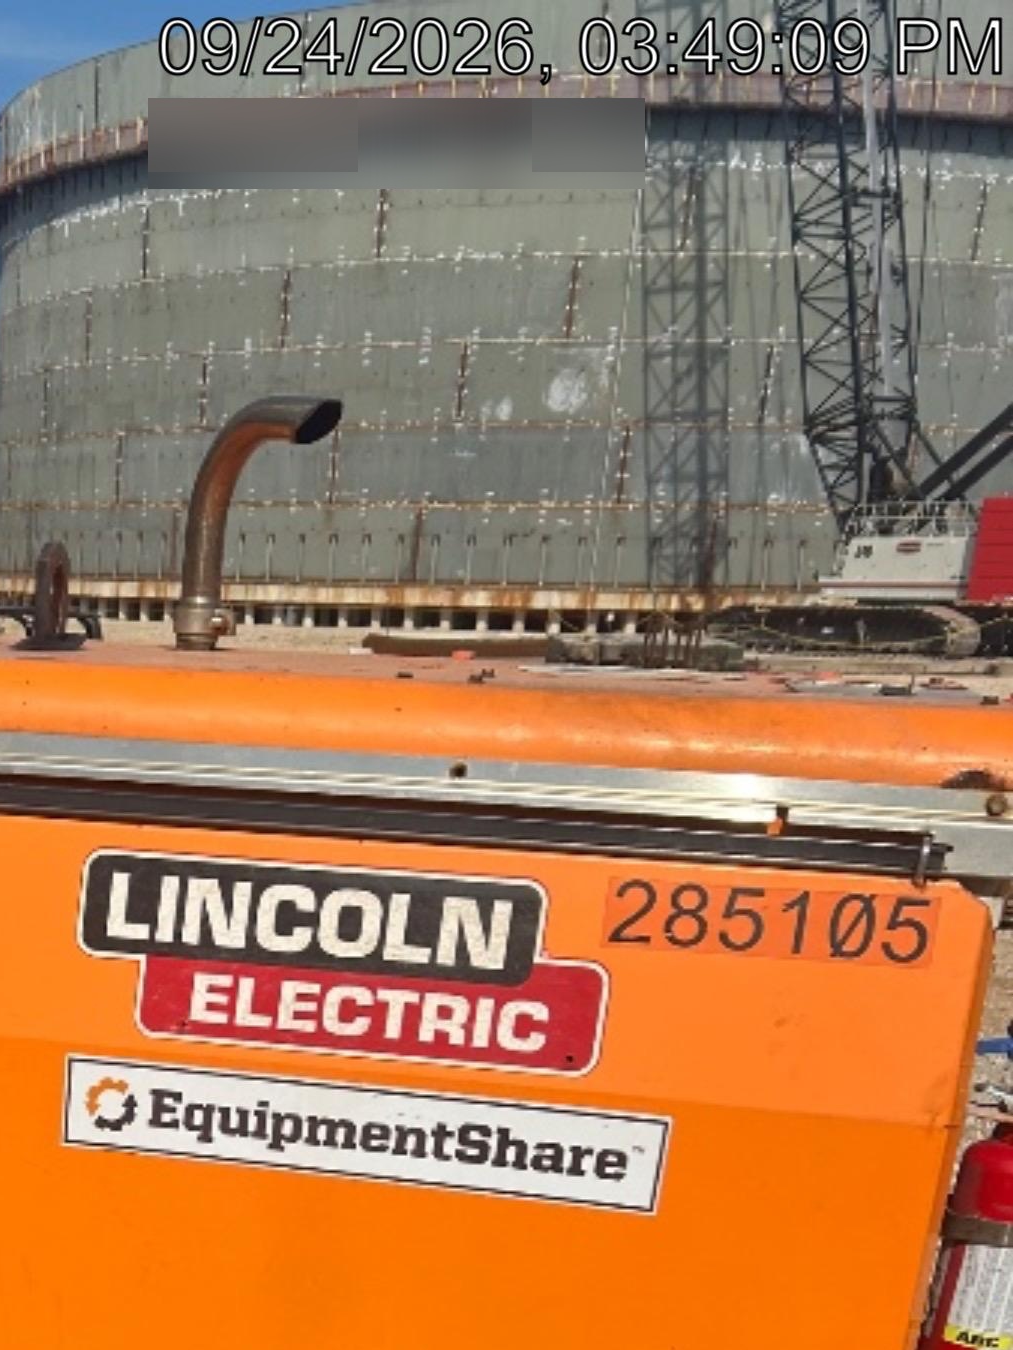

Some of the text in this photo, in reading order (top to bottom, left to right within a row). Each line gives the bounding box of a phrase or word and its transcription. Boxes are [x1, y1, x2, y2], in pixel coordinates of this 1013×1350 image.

[105, 871, 514, 970] LINCOLN
[607, 878, 932, 964] 285105
[189, 971, 550, 1053] ELECTRIC
[147, 1087, 629, 1183] EquipmentShare
